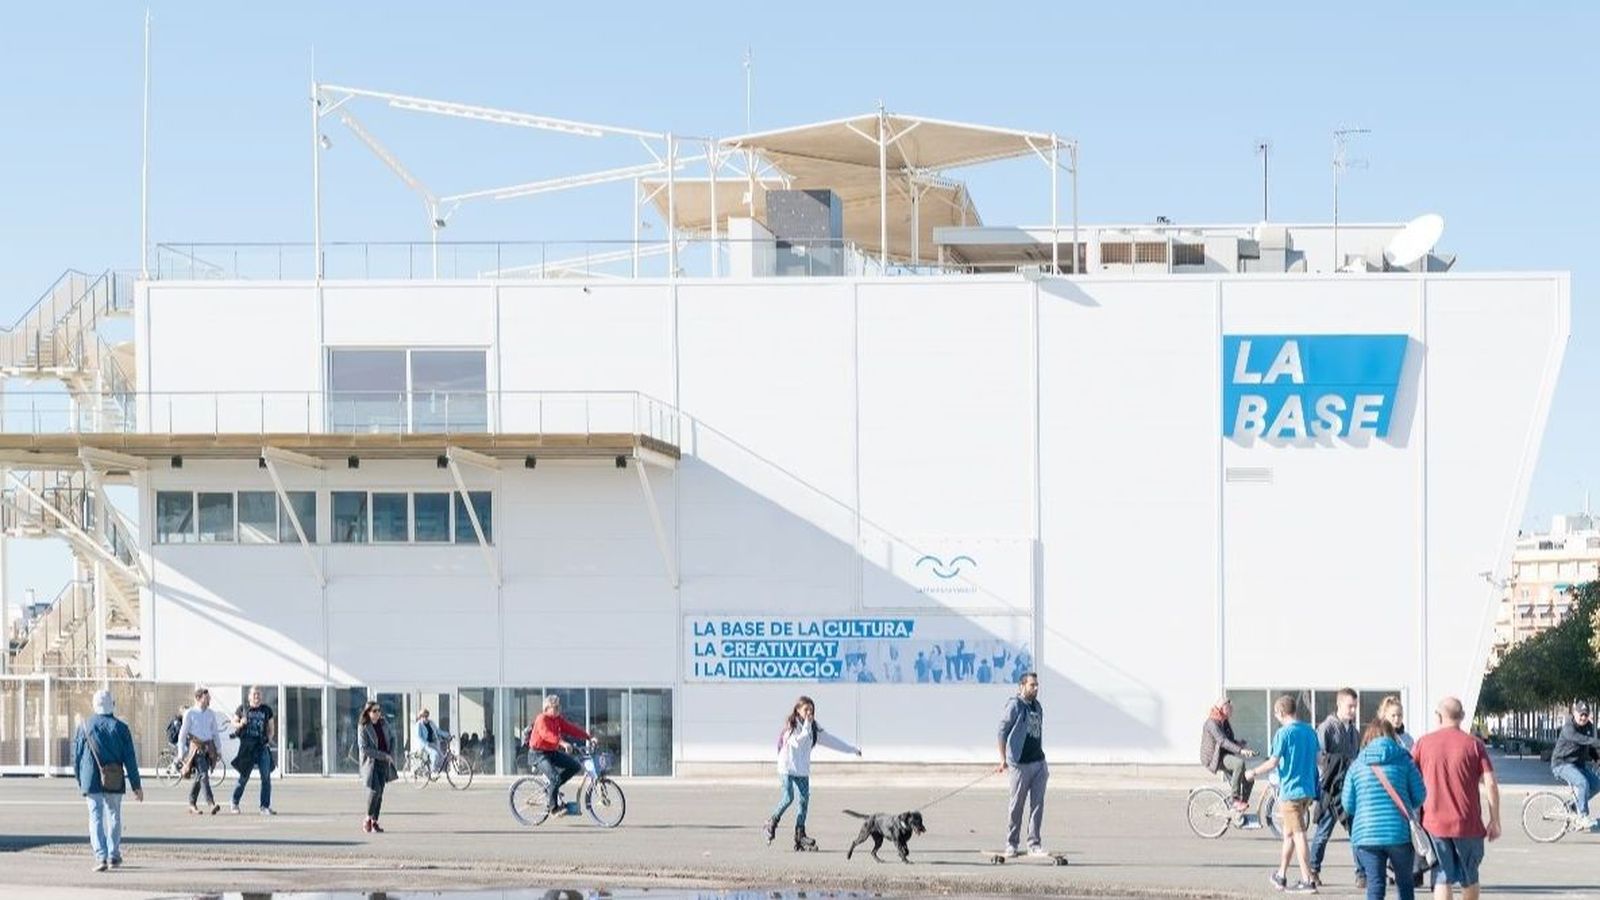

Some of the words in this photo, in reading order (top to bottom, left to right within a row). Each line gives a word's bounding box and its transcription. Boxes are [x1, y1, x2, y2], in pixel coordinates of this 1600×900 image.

[1233, 340, 1304, 384] LA
[1233, 394, 1384, 439] BASE
[694, 622, 716, 637] LA
[721, 622, 765, 637] BASE
[771, 622, 793, 637] DE
[799, 622, 820, 637] LA
[694, 642, 716, 657] LA
[722, 641, 837, 657] CREATIVITAT
[695, 662, 699, 677] I
[704, 662, 726, 677] LA
[730, 660, 839, 677] INNOVACIÓ.
